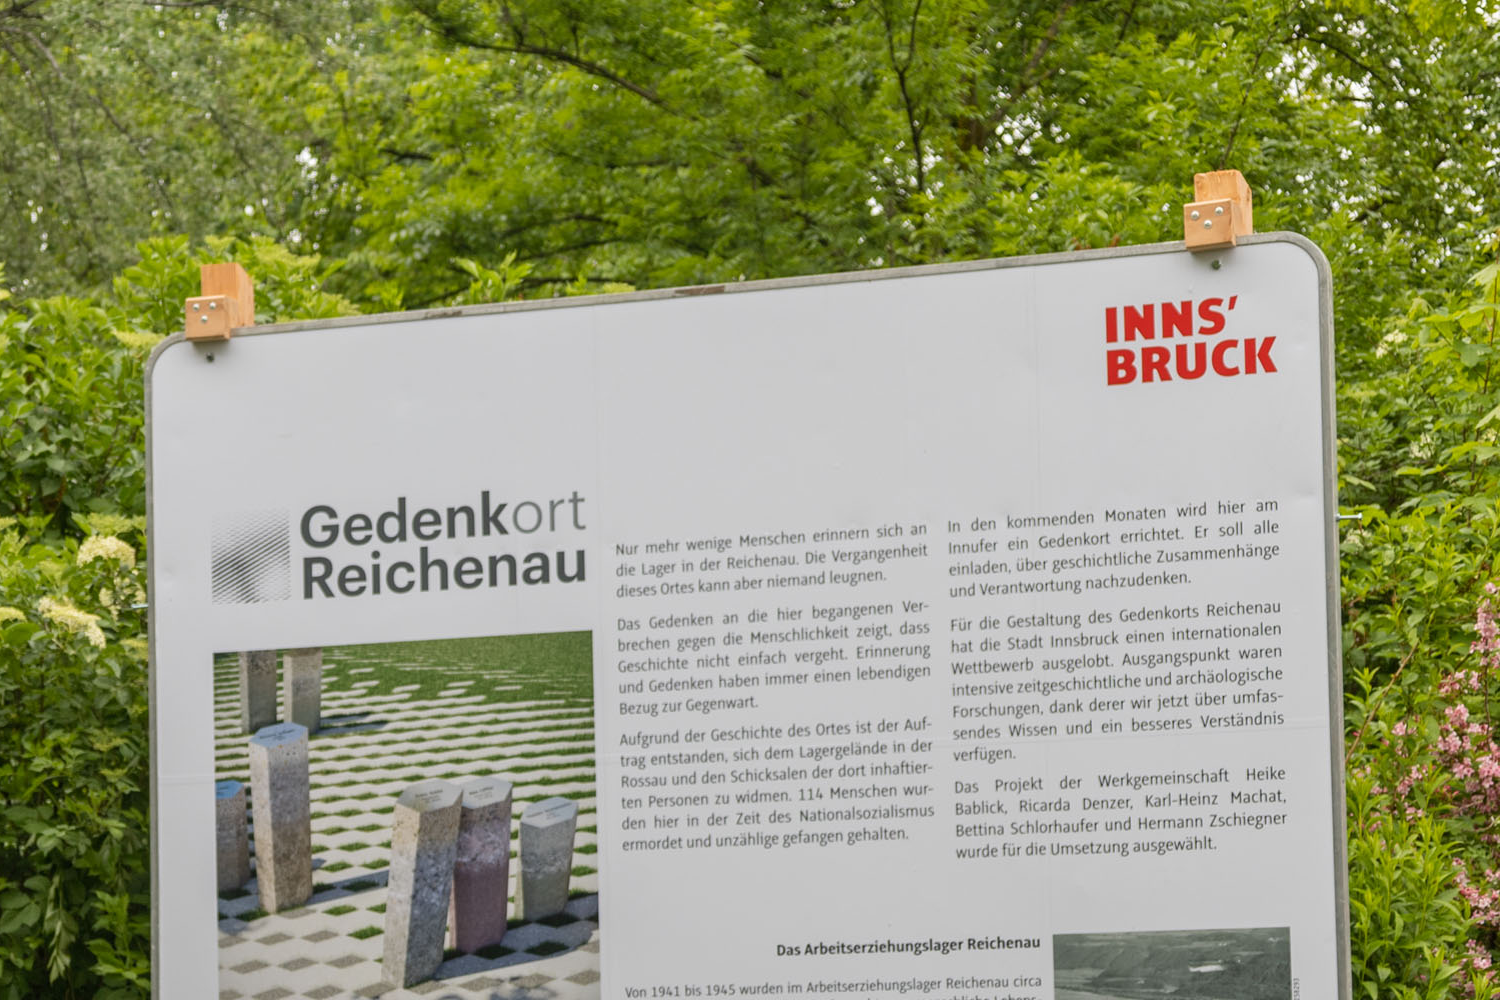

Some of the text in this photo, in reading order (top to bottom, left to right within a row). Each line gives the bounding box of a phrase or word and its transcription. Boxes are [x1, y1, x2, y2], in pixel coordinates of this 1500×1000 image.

[1105, 295, 1238, 343] INNS'
[1106, 336, 1278, 386] BRUCK
[300, 490, 587, 549] Gedenkort
[615, 522, 926, 555] Nur mehr wenige Menschen erinnern sich an
[948, 519, 1278, 554] Innufer ein Gedenkort errichtet. Er soll alle
[303, 546, 586, 600] Reichenau
[615, 543, 928, 578] die Lager in der Reichenau. Die Vergangenheit
[948, 543, 1279, 576] einladen, über geschichtliche Zusammenhänge
[949, 570, 1191, 598] und Verantwortung nachzudenken.
[950, 600, 1280, 631] Für die Gestaltung des Gedenkorts Reichenau
[617, 620, 930, 652] brechen gegen die Menschlichkeit zeigt, dass
[617, 644, 930, 673] Geschichte nicht einfach vergeht. Erinnerung
[950, 646, 1281, 675] Wettbewerb ausgelobt. Ausgangspunkt waren
[952, 666, 1283, 696] intensive zeitgeschichtliche und archäologische
[619, 695, 758, 717] Bezug zur Gegenwart.
[952, 745, 1016, 764] verfügen.
[620, 759, 932, 788] Rossau und den Schicksalen der dort inhaftier-
[954, 765, 1285, 794] Das Projekt der Werkgemeinschaft Heike
[955, 788, 1286, 815] Bablick, Ricarda Denzer, Karl-Heinz Machat,
[621, 826, 908, 851] ermordet und unzählige gefangen gehalten.
[955, 811, 1287, 837] Bettina Schlorhaufer und Hermann Zschiegner
[776, 935, 1040, 956] Das Arbeitserziehungslager Reichenau
[624, 975, 1041, 998] Von 1941 bis 1945 wurden im Arbeitserziehungslager Reichenau circa
